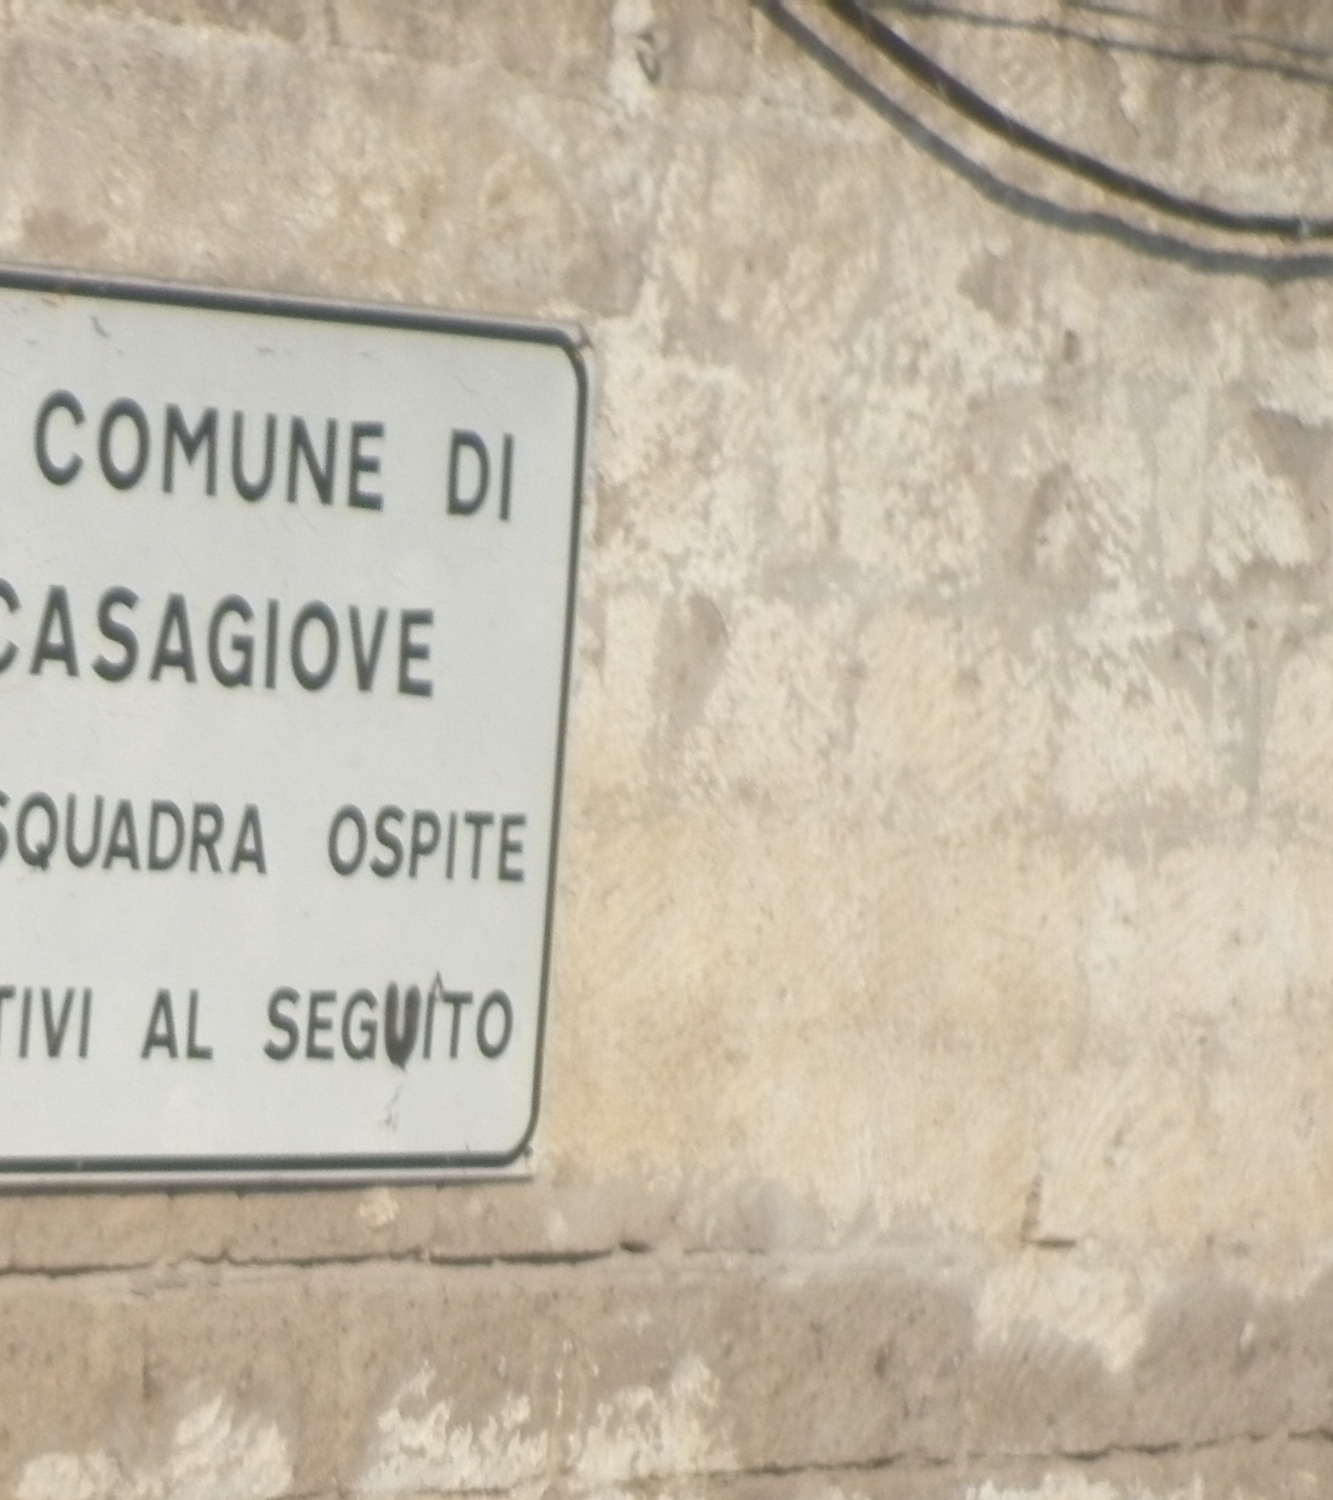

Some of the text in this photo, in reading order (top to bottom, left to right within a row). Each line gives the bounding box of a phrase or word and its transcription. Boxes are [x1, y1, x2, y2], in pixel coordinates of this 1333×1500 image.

[32, 387, 387, 514] COMUNE
[443, 427, 517, 523] DI
[325, 803, 529, 885] OSPITE
[138, 987, 215, 1063] AL
[262, 980, 516, 1071] SEGUITO
